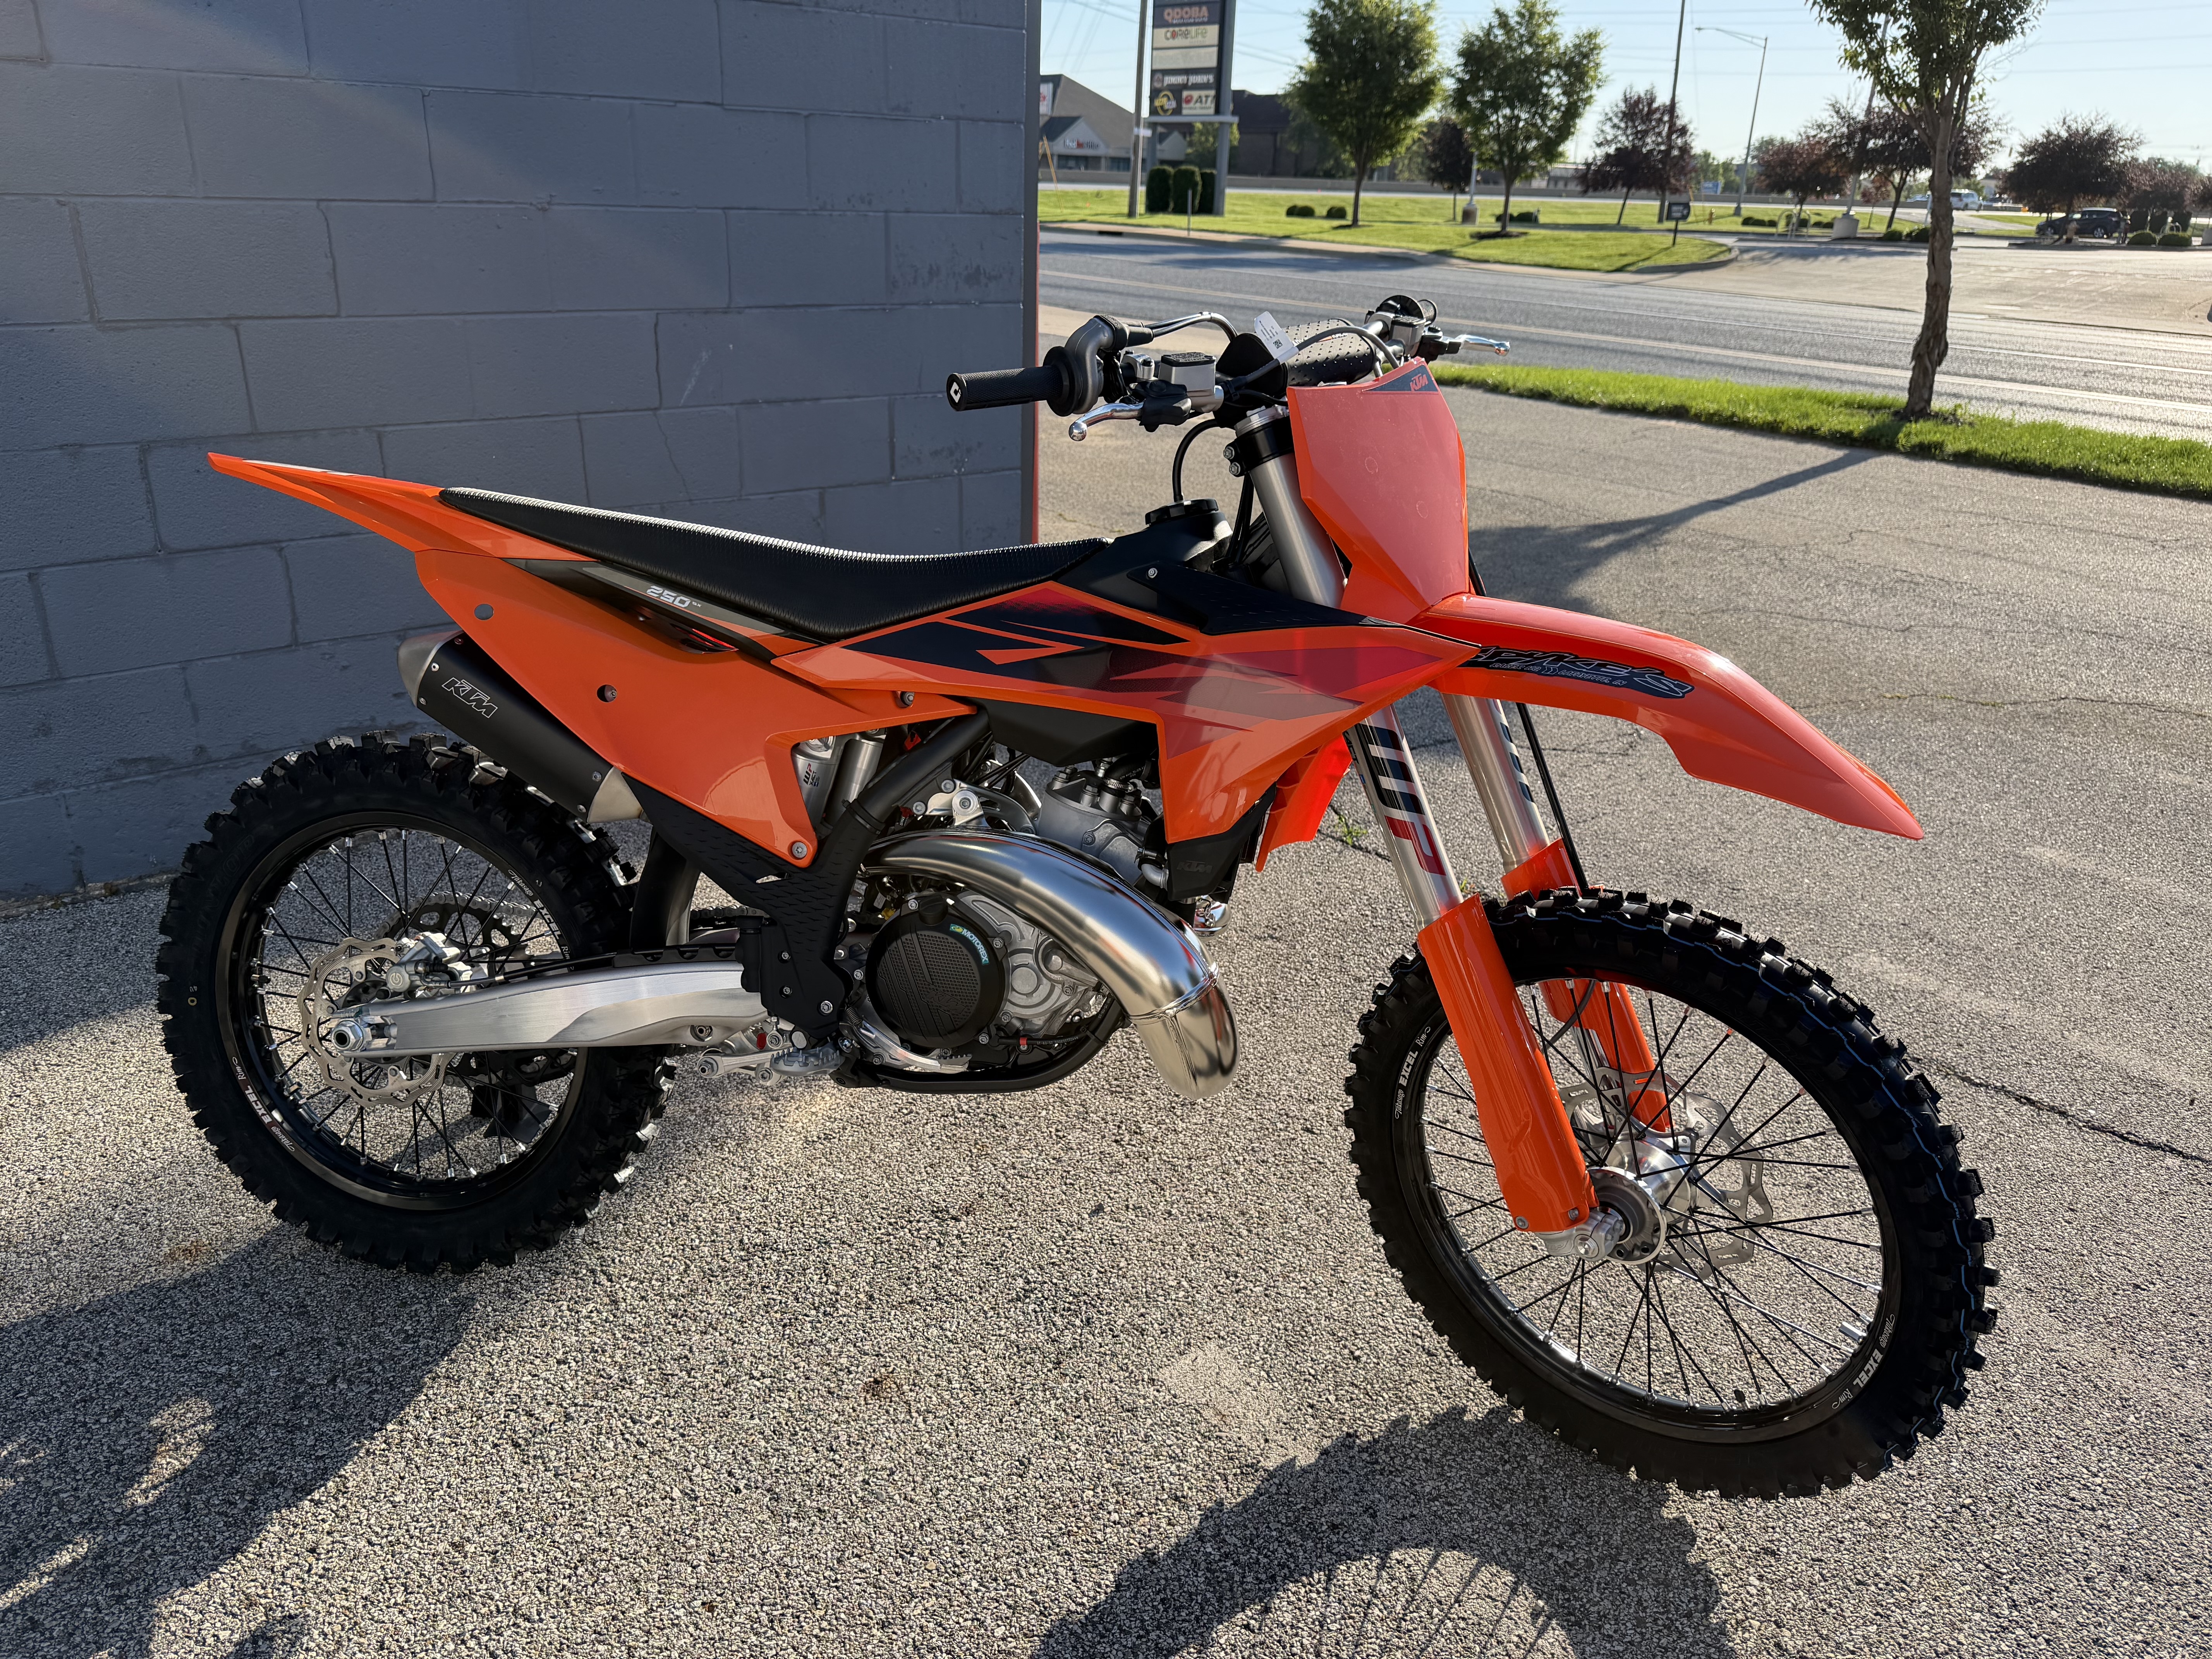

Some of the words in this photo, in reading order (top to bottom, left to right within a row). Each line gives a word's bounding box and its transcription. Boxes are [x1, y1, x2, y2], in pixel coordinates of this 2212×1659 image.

[1163, 6, 1209, 23] QDOBA
[1410, 373, 1429, 392] KTM
[646, 586, 691, 608] 250
[441, 677, 498, 718] KTM
[1176, 860, 1213, 874] KTM
[508, 869, 534, 896] Takasago
[533, 898, 562, 940] EXCEL
[962, 929, 989, 963] MOTOREX
[929, 991, 967, 1015] KTM
[1415, 1026, 1431, 1047] Rim
[232, 1056, 246, 1080] Rim
[1399, 1051, 1419, 1087] EXCEL
[245, 1085, 273, 1125] EXCEL
[1395, 1089, 1405, 1119] Takasago
[271, 1126, 295, 1152] Takasago
[1879, 1314, 1895, 1348] Takasago
[1853, 1348, 1884, 1388] EXCEL
[1832, 1388, 1853, 1409] Rim
